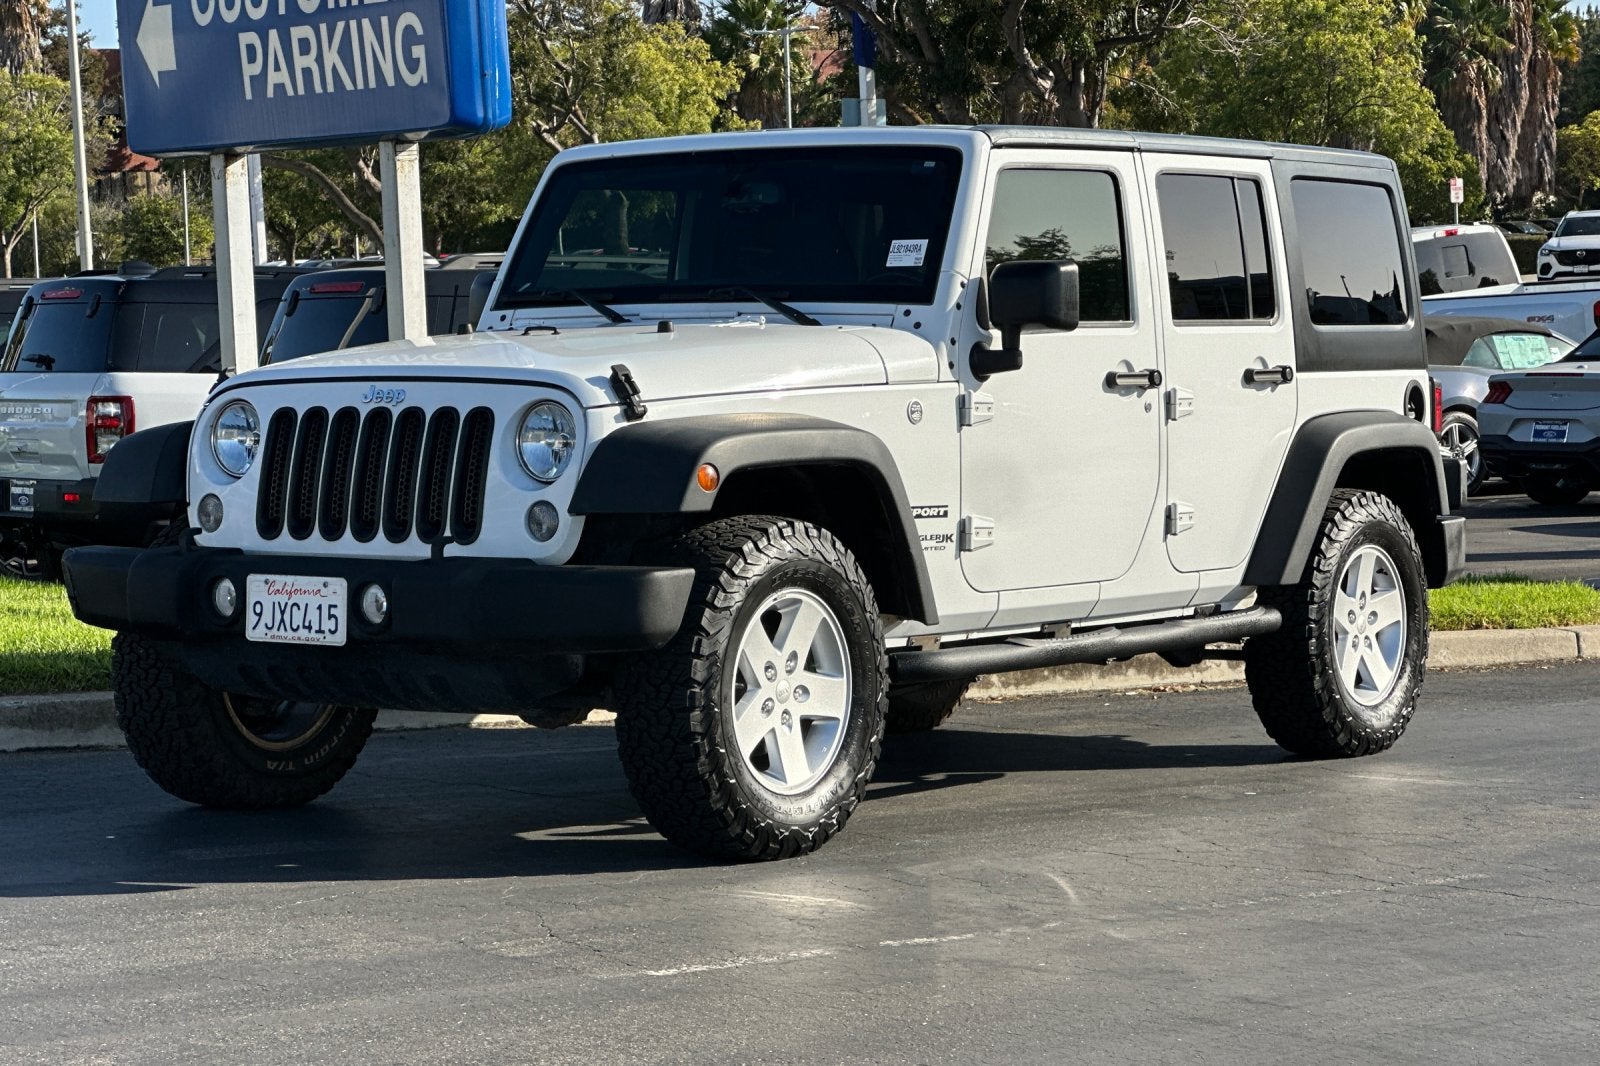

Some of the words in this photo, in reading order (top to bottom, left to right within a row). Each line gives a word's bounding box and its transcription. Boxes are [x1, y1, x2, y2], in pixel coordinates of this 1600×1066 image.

[238, 11, 428, 100] PARKING
[361, 384, 406, 407] Jeep
[0, 406, 52, 414] BRONCO
[911, 506, 948, 517] PORT
[267, 580, 328, 600] California
[252, 600, 339, 635] 9JXC415
[270, 633, 321, 641] dmv.ca.gov
